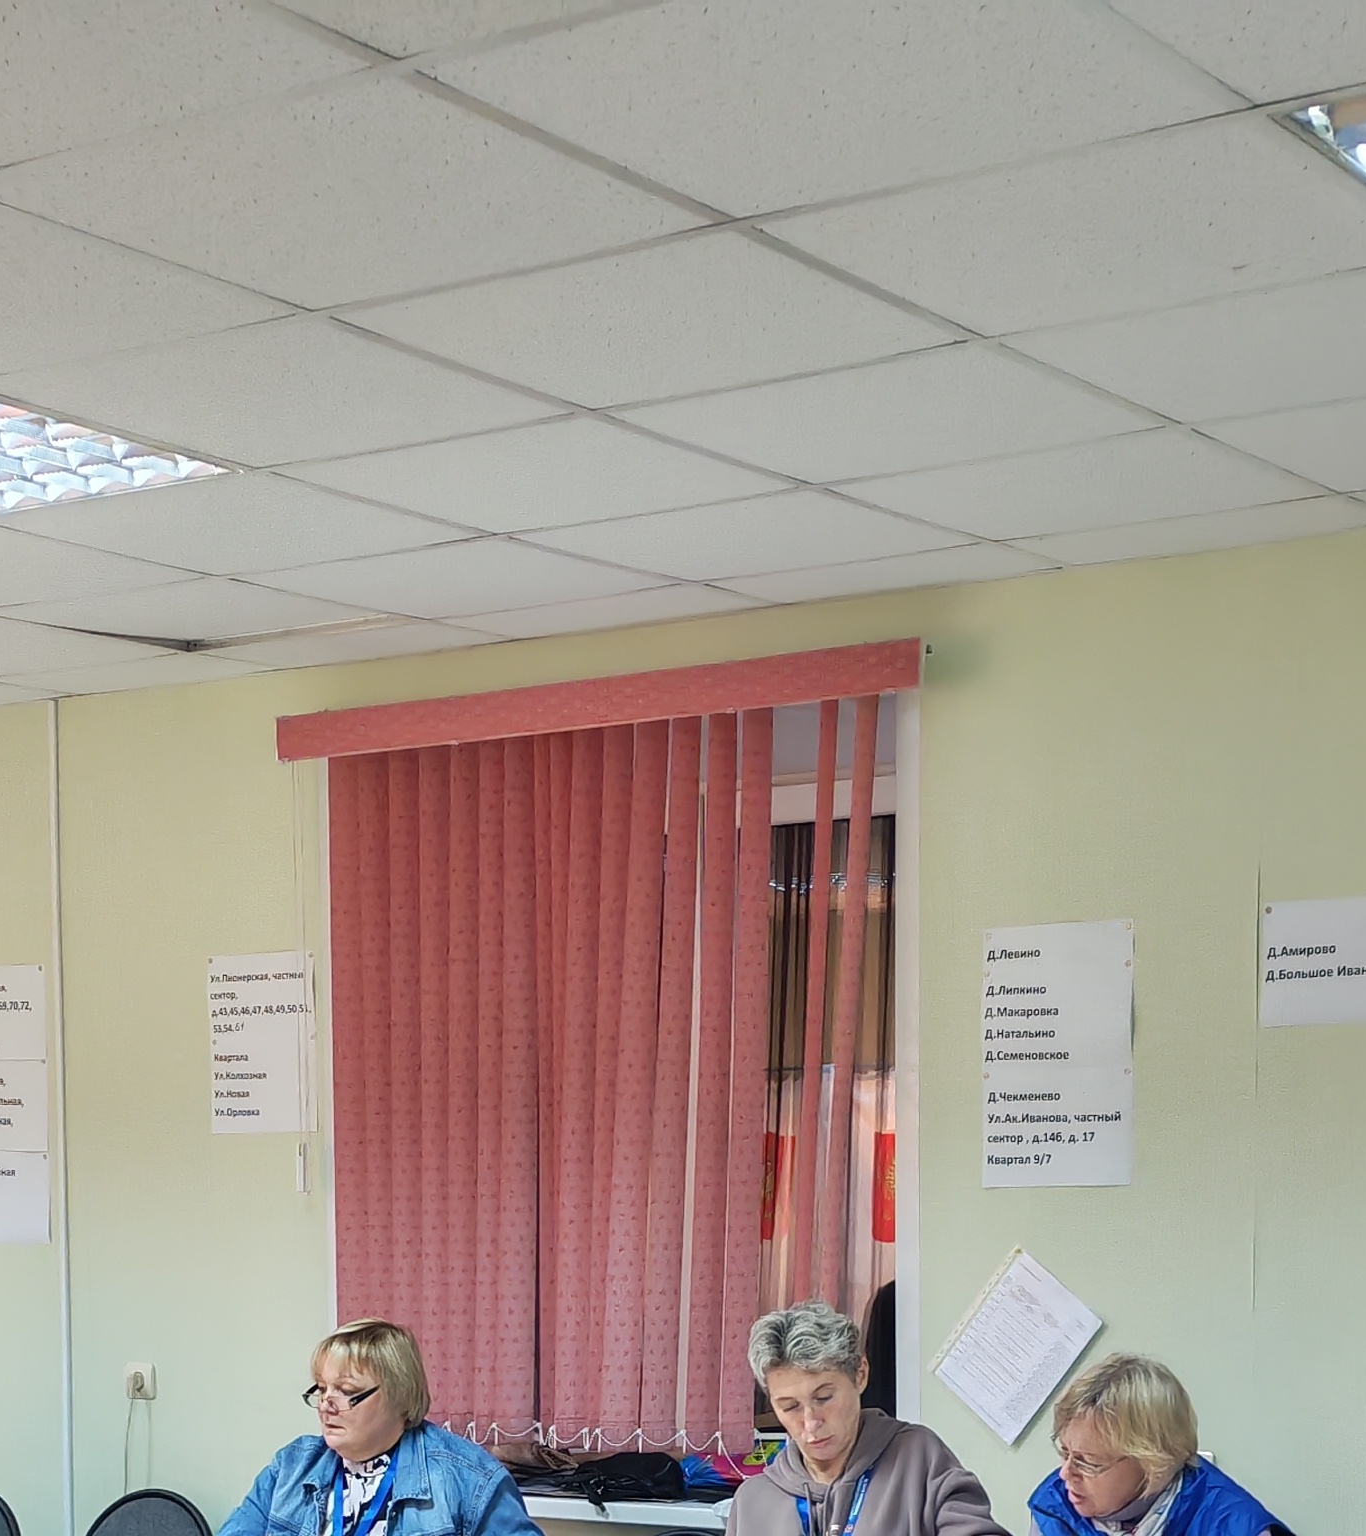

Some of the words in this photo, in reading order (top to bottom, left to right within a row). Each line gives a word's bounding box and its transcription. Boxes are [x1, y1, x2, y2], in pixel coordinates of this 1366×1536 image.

[986, 949, 1041, 962] Д.Левино
[1267, 945, 1337, 960] Д.Амирово
[1265, 968, 1334, 983] Д.Большое
[985, 985, 1047, 997] Д.Липкино
[984, 1007, 1059, 1020] Д.Макаровка
[984, 1029, 1056, 1041] Д.Натальино
[984, 1050, 1070, 1062] Д.Семеновское
[987, 1092, 1061, 1104] Д.Чекменево
[987, 1113, 1072, 1124] Ул.Ак.Иванова,
[1074, 1110, 1122, 1122] частный
[1082, 1131, 1095, 1142] 17
[987, 1154, 1031, 1166] Квартал
[1033, 1152, 1052, 1166] 9/7
